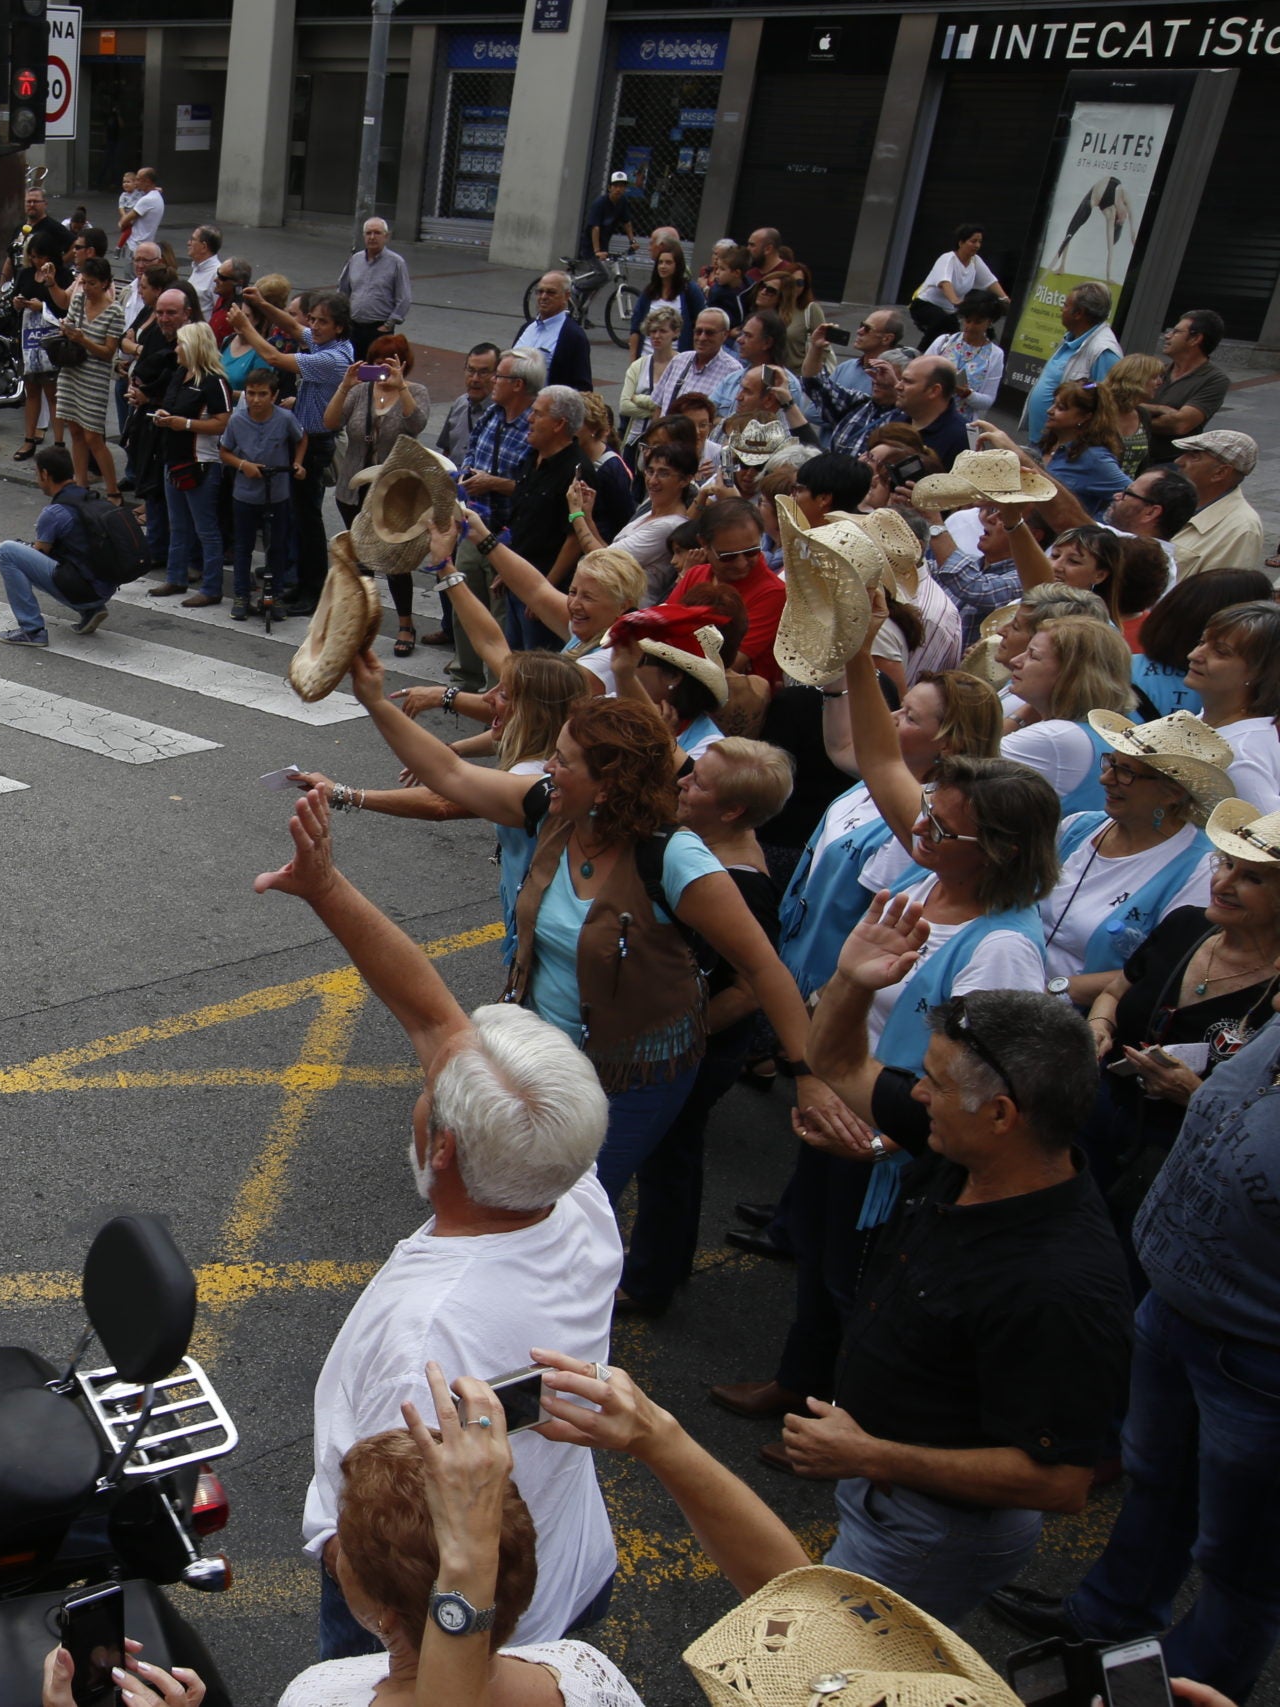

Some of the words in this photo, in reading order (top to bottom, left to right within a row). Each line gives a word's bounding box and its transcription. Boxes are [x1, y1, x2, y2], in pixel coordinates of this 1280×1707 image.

[48, 20, 75, 39] NA
[989, 19, 1191, 60] INTECAT
[1080, 131, 1155, 158] PILATES
[1034, 284, 1067, 308] Pilate
